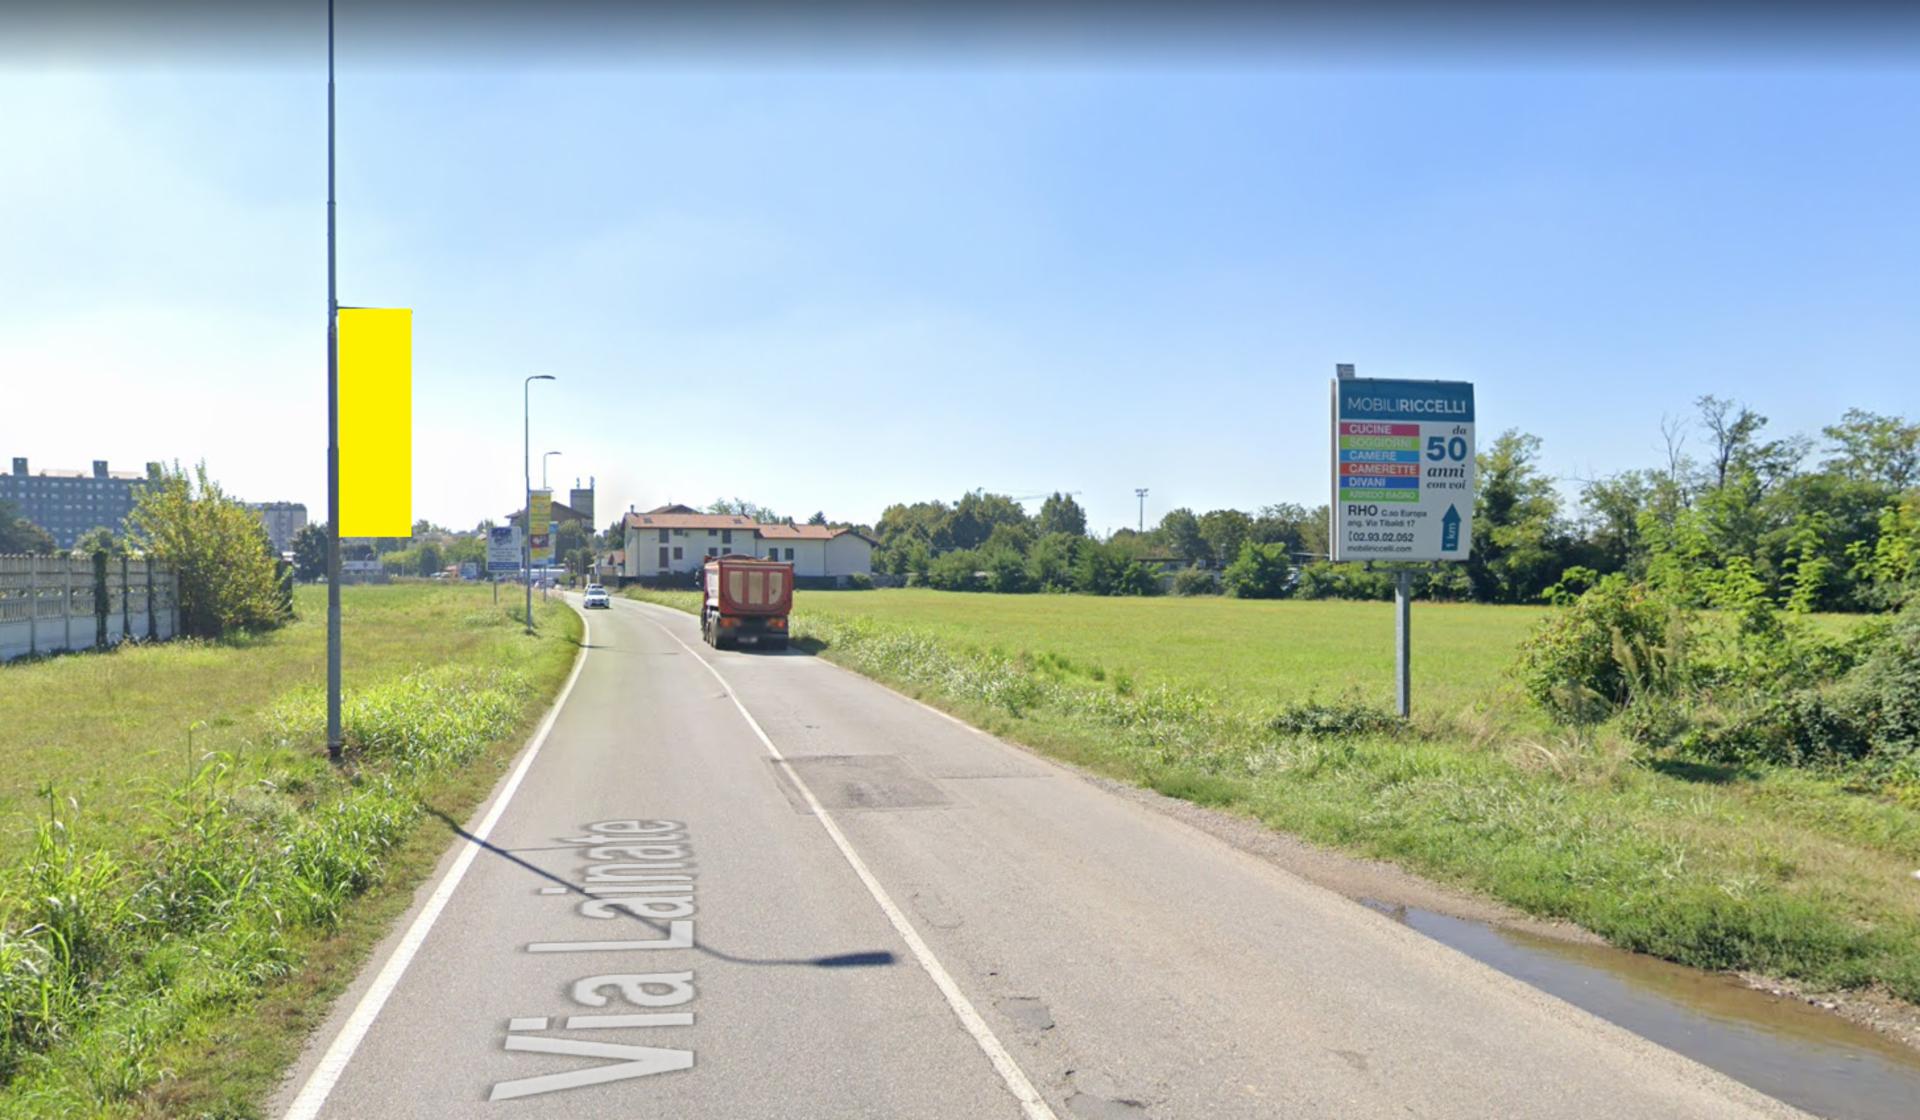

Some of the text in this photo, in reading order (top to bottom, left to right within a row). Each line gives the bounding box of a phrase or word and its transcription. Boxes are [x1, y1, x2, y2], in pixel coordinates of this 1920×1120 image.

[1347, 397, 1466, 413] MOBILIRICCELLI
[1349, 425, 1392, 434] CUCINE
[1452, 425, 1466, 435] da
[1426, 436, 1467, 461] 50
[1349, 451, 1396, 461] CAMERE
[1349, 464, 1416, 474] CAMERETTE
[1427, 463, 1465, 478] anni
[1349, 478, 1386, 487] DIVANI
[1427, 479, 1466, 490] con voi
[1348, 505, 1377, 516] RHO
[1400, 510, 1427, 518] Europa
[1347, 520, 1363, 528] ang.
[1366, 519, 1377, 527] Via
[1447, 523, 1457, 539] km
[1353, 532, 1413, 542] 02.93.02.052
